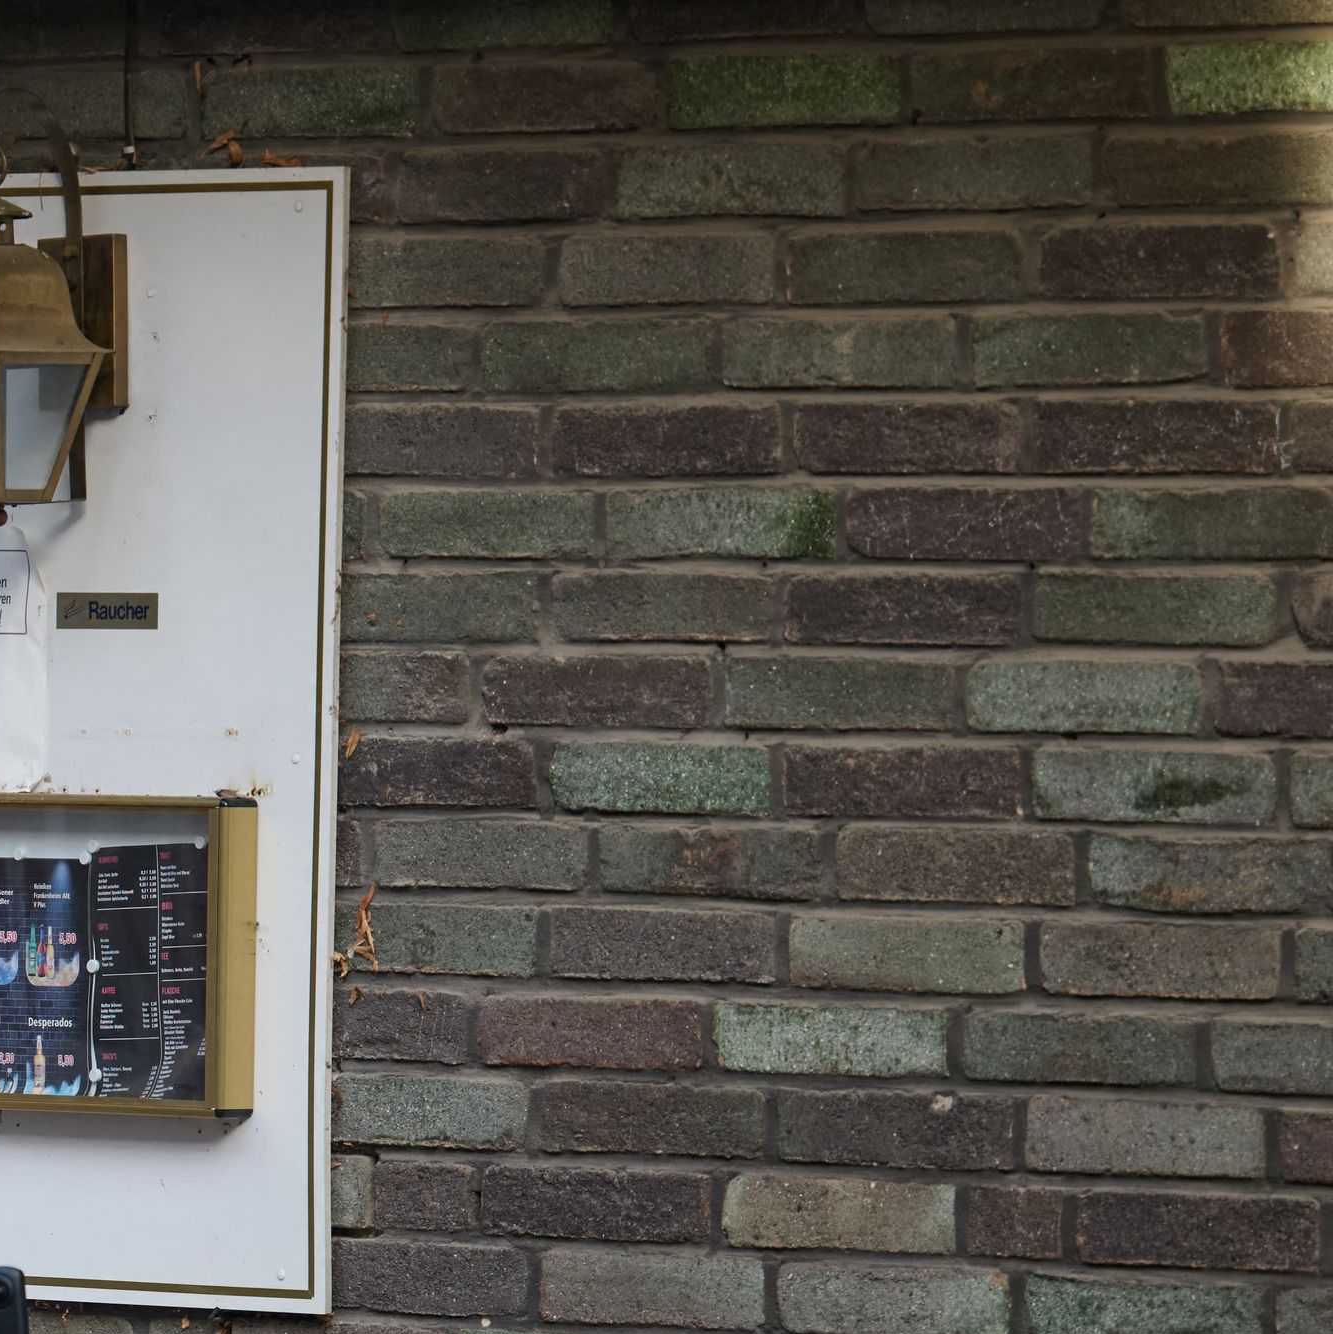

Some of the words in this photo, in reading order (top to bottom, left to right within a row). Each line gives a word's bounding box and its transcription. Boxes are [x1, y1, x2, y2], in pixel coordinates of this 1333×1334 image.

[88, 601, 150, 621] Raucher
[58, 932, 77, 946] 3,50
[28, 1017, 73, 1029] Desperados
